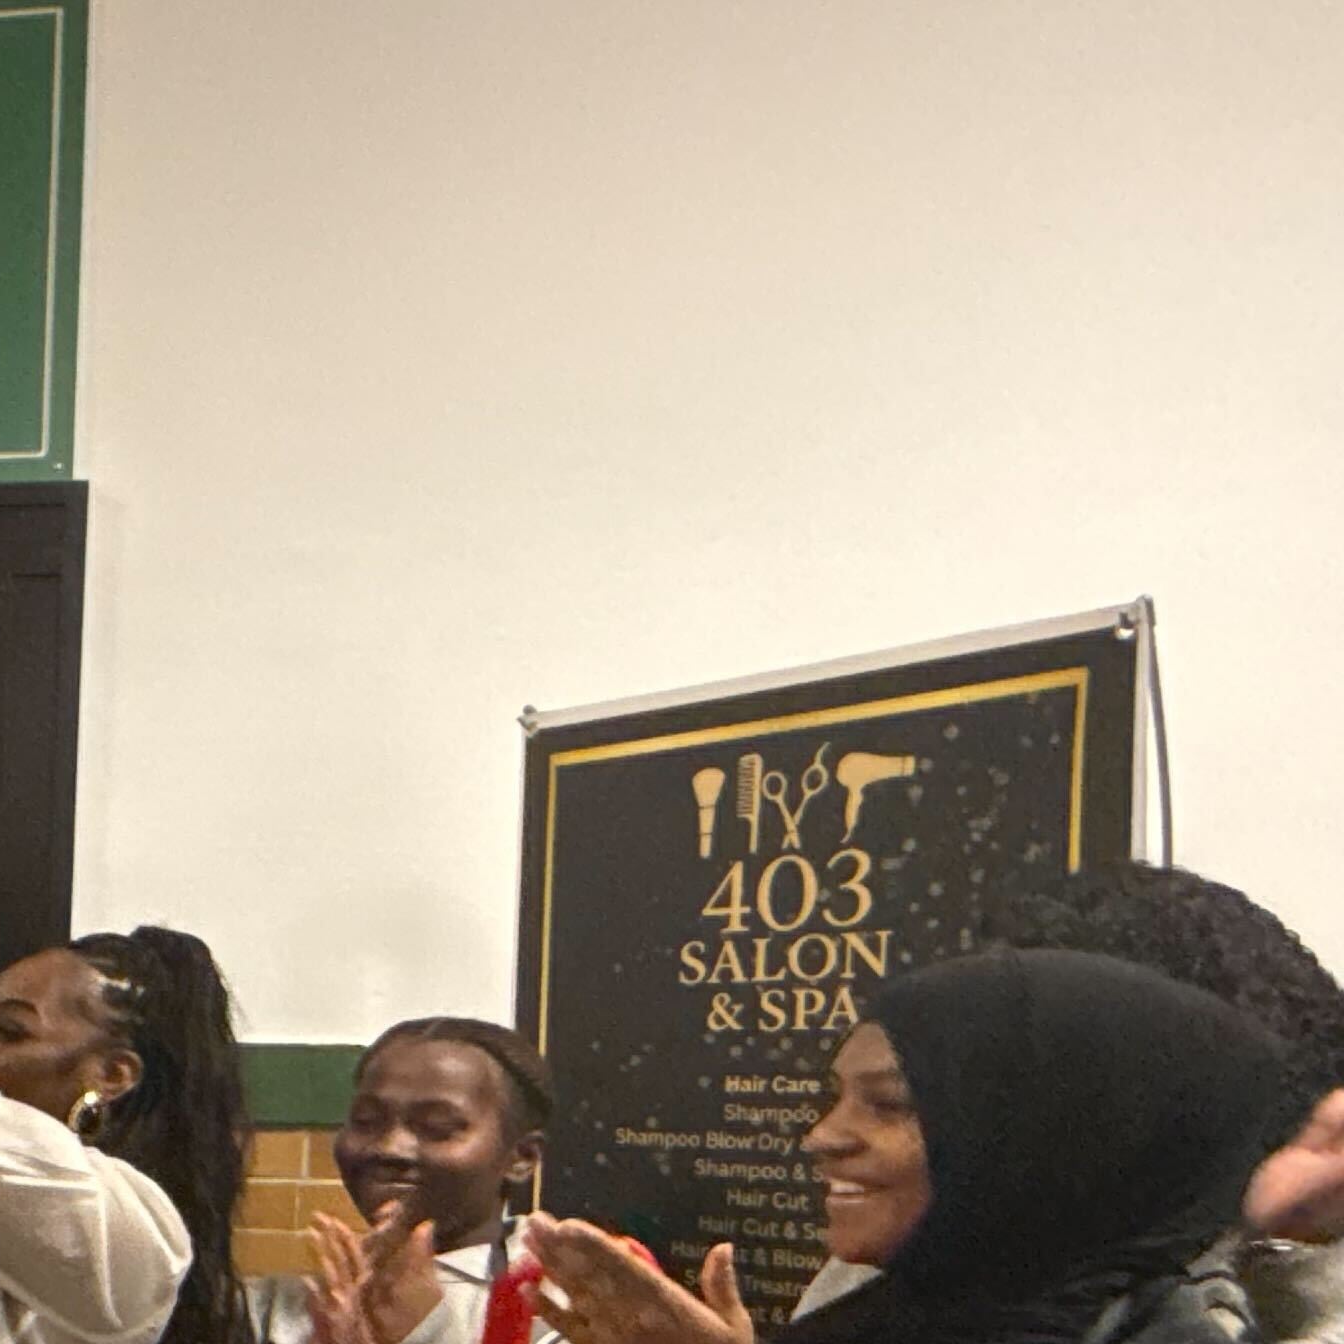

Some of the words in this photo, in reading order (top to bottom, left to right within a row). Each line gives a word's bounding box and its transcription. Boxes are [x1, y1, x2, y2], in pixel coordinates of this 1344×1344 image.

[701, 848, 873, 933] 403
[678, 930, 894, 986] SALON
[707, 992, 744, 1032] &
[758, 985, 859, 1032] SPA
[723, 1074, 767, 1094] Hair
[771, 1075, 822, 1095] Care
[723, 1103, 820, 1127] Shampoo
[614, 1127, 701, 1151] Shampoo
[705, 1130, 755, 1150] Blow
[757, 1133, 795, 1158] Dry
[693, 1158, 788, 1183] Shampoo
[792, 1163, 807, 1181] &
[726, 1187, 769, 1209] Hair
[771, 1191, 811, 1212] Cut
[697, 1215, 738, 1235] Hair
[742, 1217, 780, 1239] Cut
[783, 1221, 799, 1241] &
[772, 1248, 823, 1271] Blow
